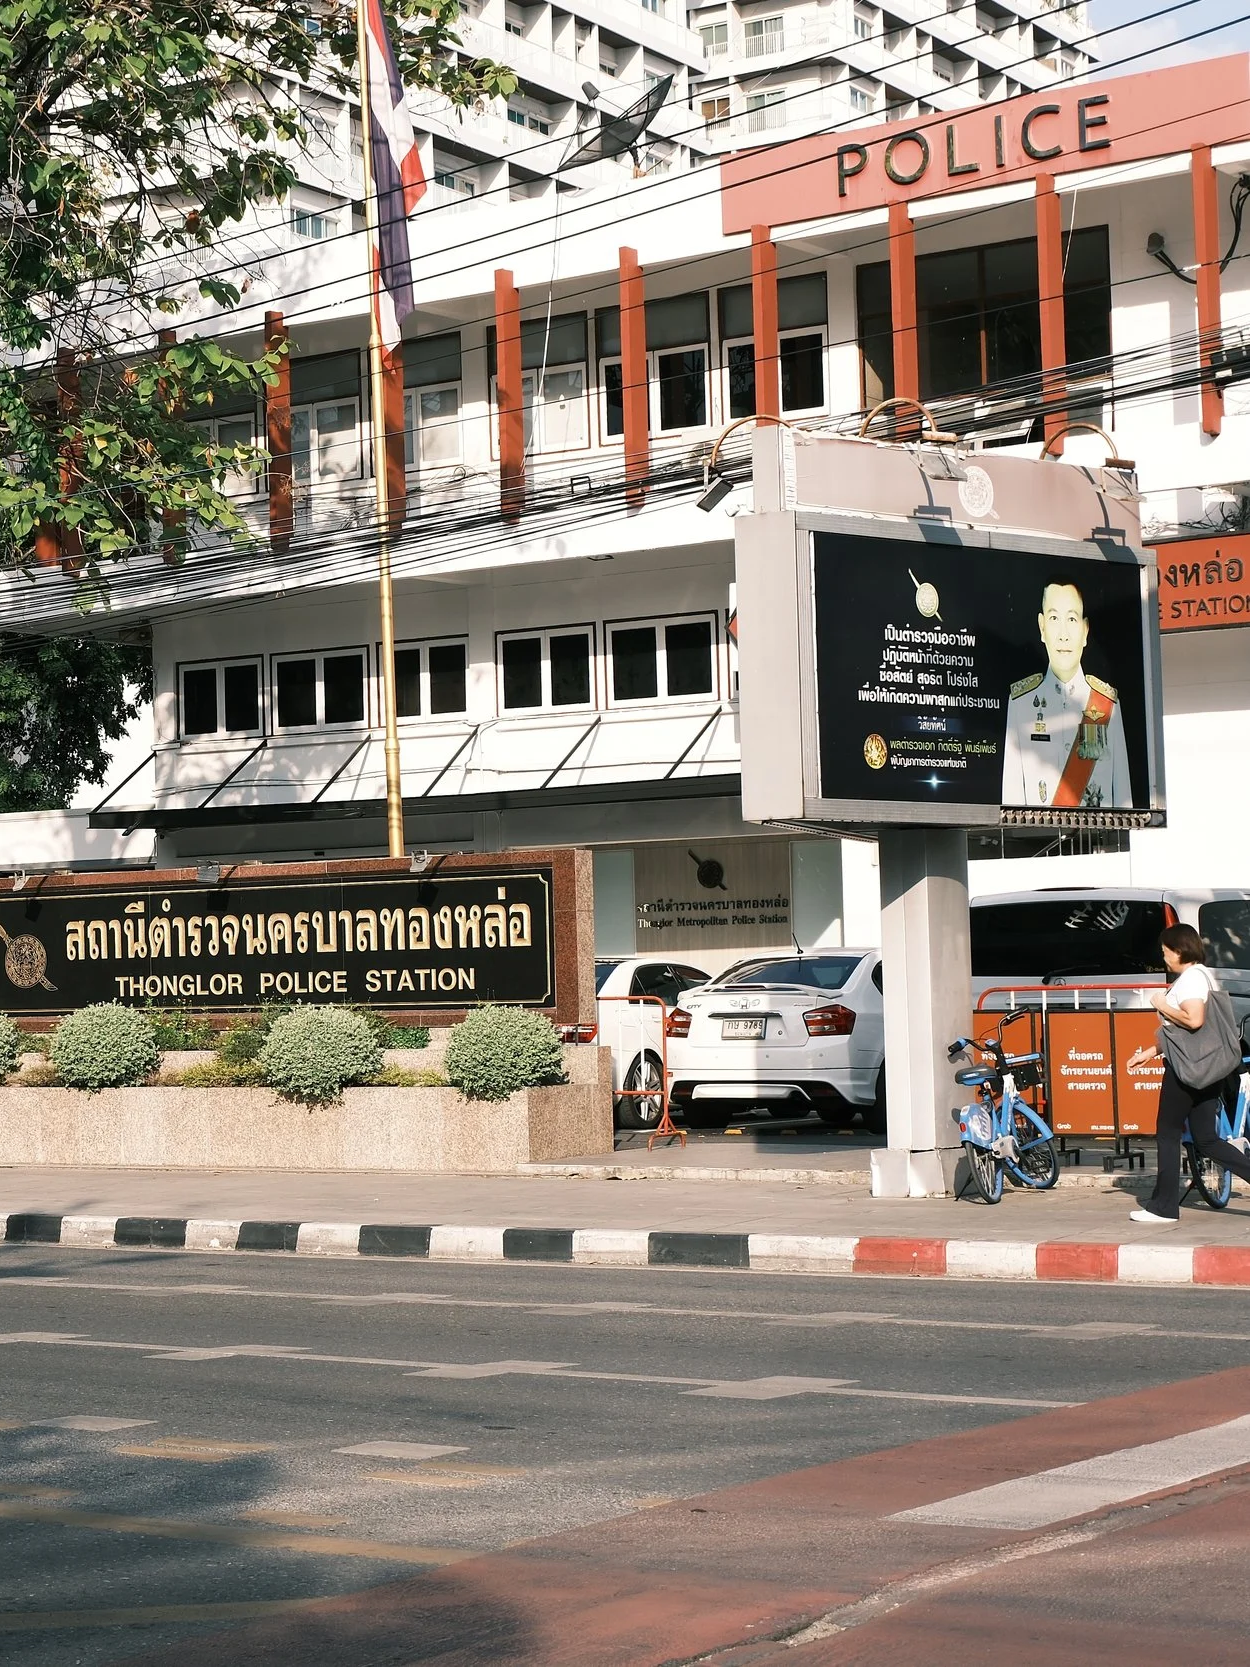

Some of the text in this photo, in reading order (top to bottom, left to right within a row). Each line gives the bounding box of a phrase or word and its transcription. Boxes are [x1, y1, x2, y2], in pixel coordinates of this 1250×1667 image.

[837, 94, 1112, 197] POLICE
[884, 623, 976, 647] เป็นตำรวจมืออาชีพ
[882, 645, 974, 667] ปฏิบัติหน้าที่ด้วยความ
[917, 669, 943, 690] สุจริต
[947, 671, 979, 688] โปร่งใส
[858, 682, 1000, 712] เพื่อให้เกิดความผาสุกแก่ประชาชน
[917, 716, 947, 731] วิสัยทัศน์
[889, 737, 936, 751] พลตำรวจเอก
[65, 886, 533, 961] สถานีตำรวจนครบาลทองหล่อ
[677, 915, 728, 928] Metropolitan
[732, 914, 756, 925] Police
[759, 913, 788, 924] Station
[115, 967, 476, 998] THONGLOR POLICE STATION
[1067, 1047, 1103, 1061] ที่จอดรถ
[1060, 1063, 1113, 1076] จักรยานยนต์
[1067, 1081, 1107, 1091] สายตรวจ
